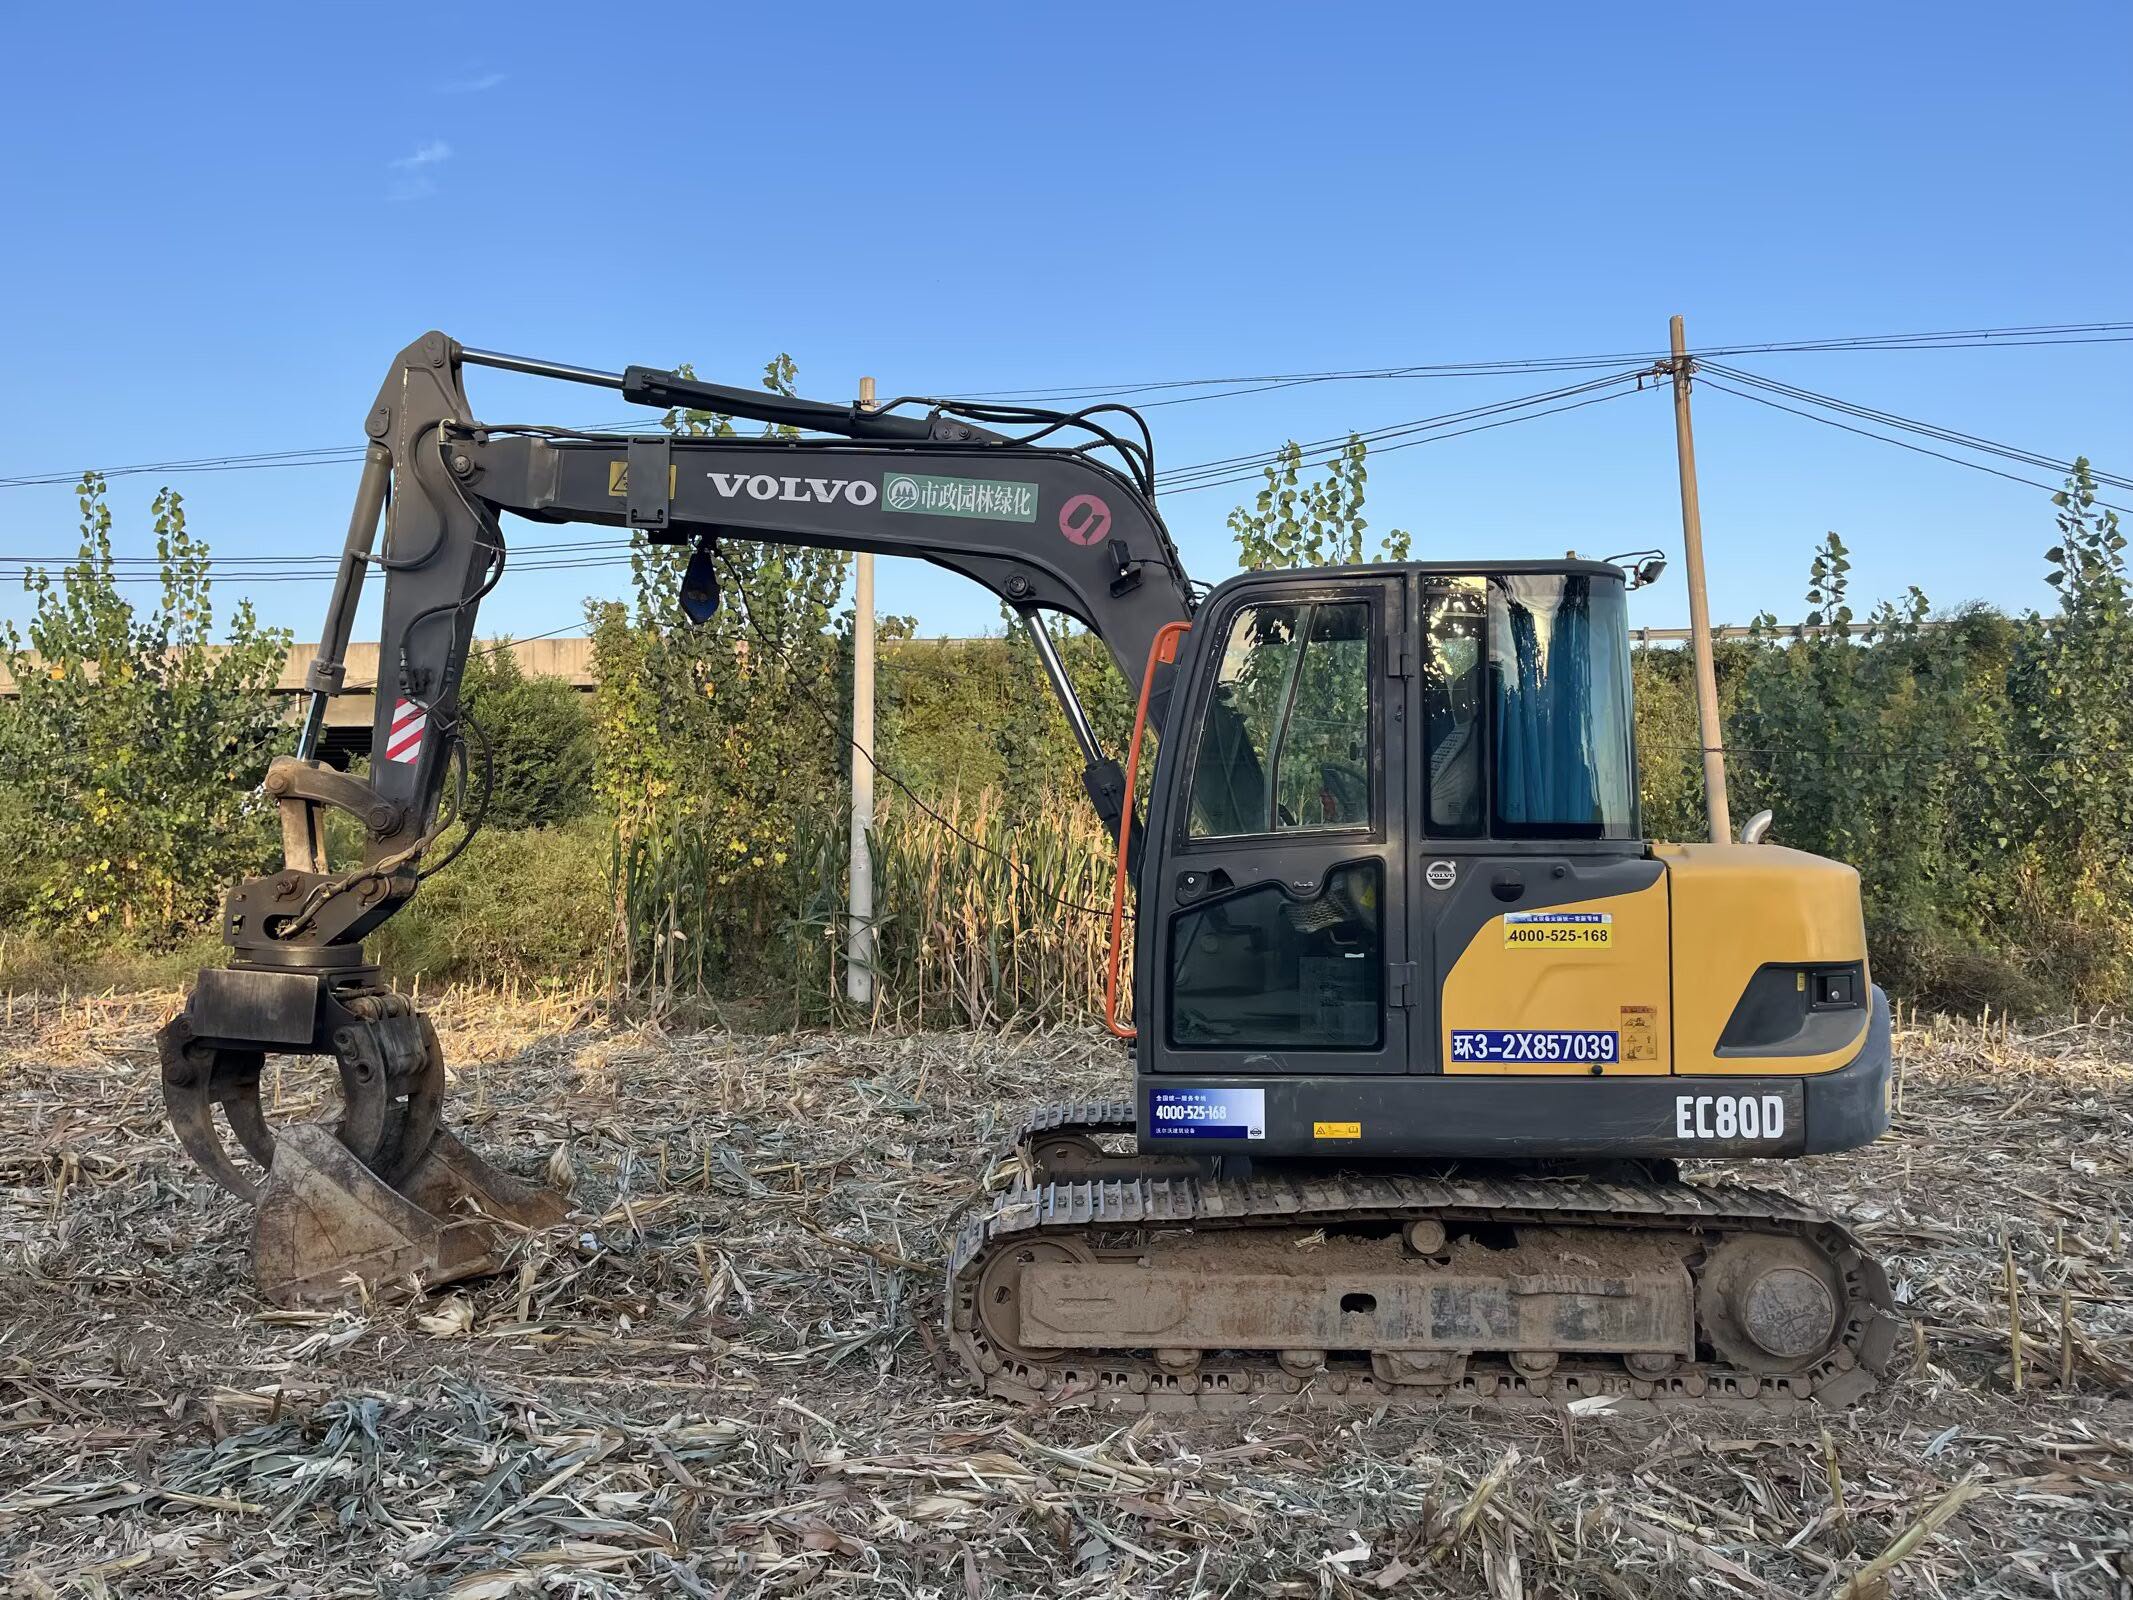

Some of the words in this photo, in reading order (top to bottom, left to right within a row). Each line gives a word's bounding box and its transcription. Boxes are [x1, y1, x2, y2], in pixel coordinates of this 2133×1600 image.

[707, 473, 877, 506] VOLVO
[921, 481, 1031, 515] 市政园林绿化
[1067, 502, 1104, 540] 01
[1509, 929, 1608, 942] 4000-525-168
[1454, 1033, 1614, 1060] 环3-2X857039
[1156, 1105, 1227, 1120] 4000-525-168
[1676, 1095, 1784, 1139] EC80D
